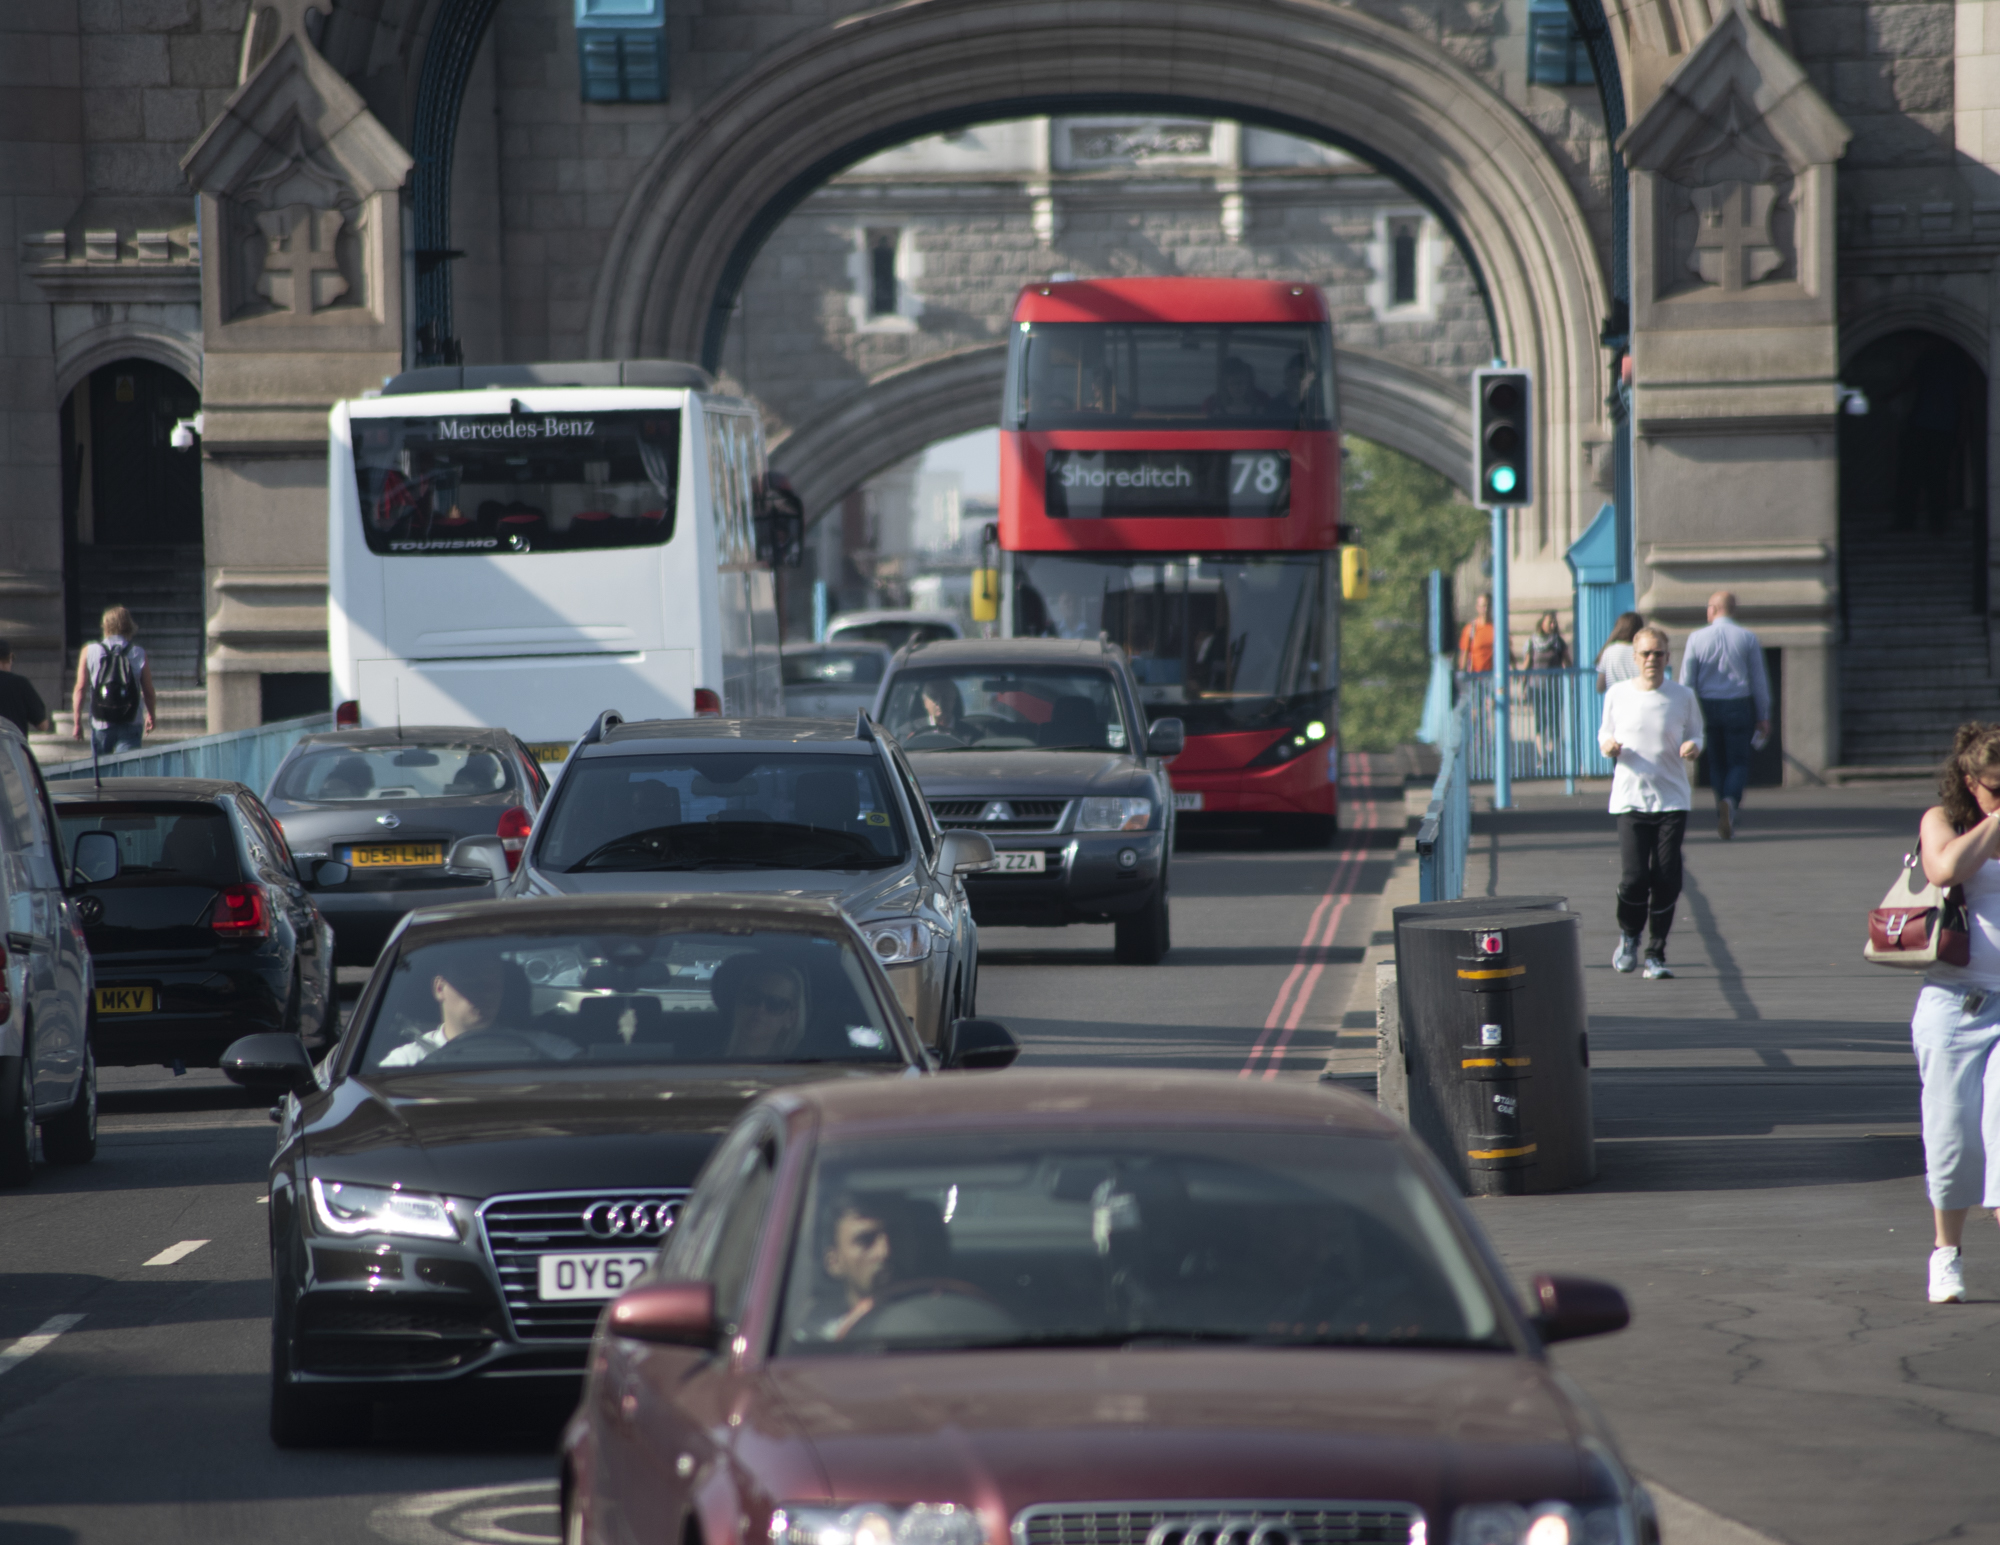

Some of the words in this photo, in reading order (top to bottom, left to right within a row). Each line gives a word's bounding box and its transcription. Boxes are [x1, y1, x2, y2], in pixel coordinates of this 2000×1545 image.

[438, 416, 595, 440] Mercedes-Benz
[1060, 464, 1192, 488] Shoreditch
[1230, 457, 1280, 495] 78
[390, 538, 499, 551] TOURISMO
[101, 990, 145, 1009] MKV
